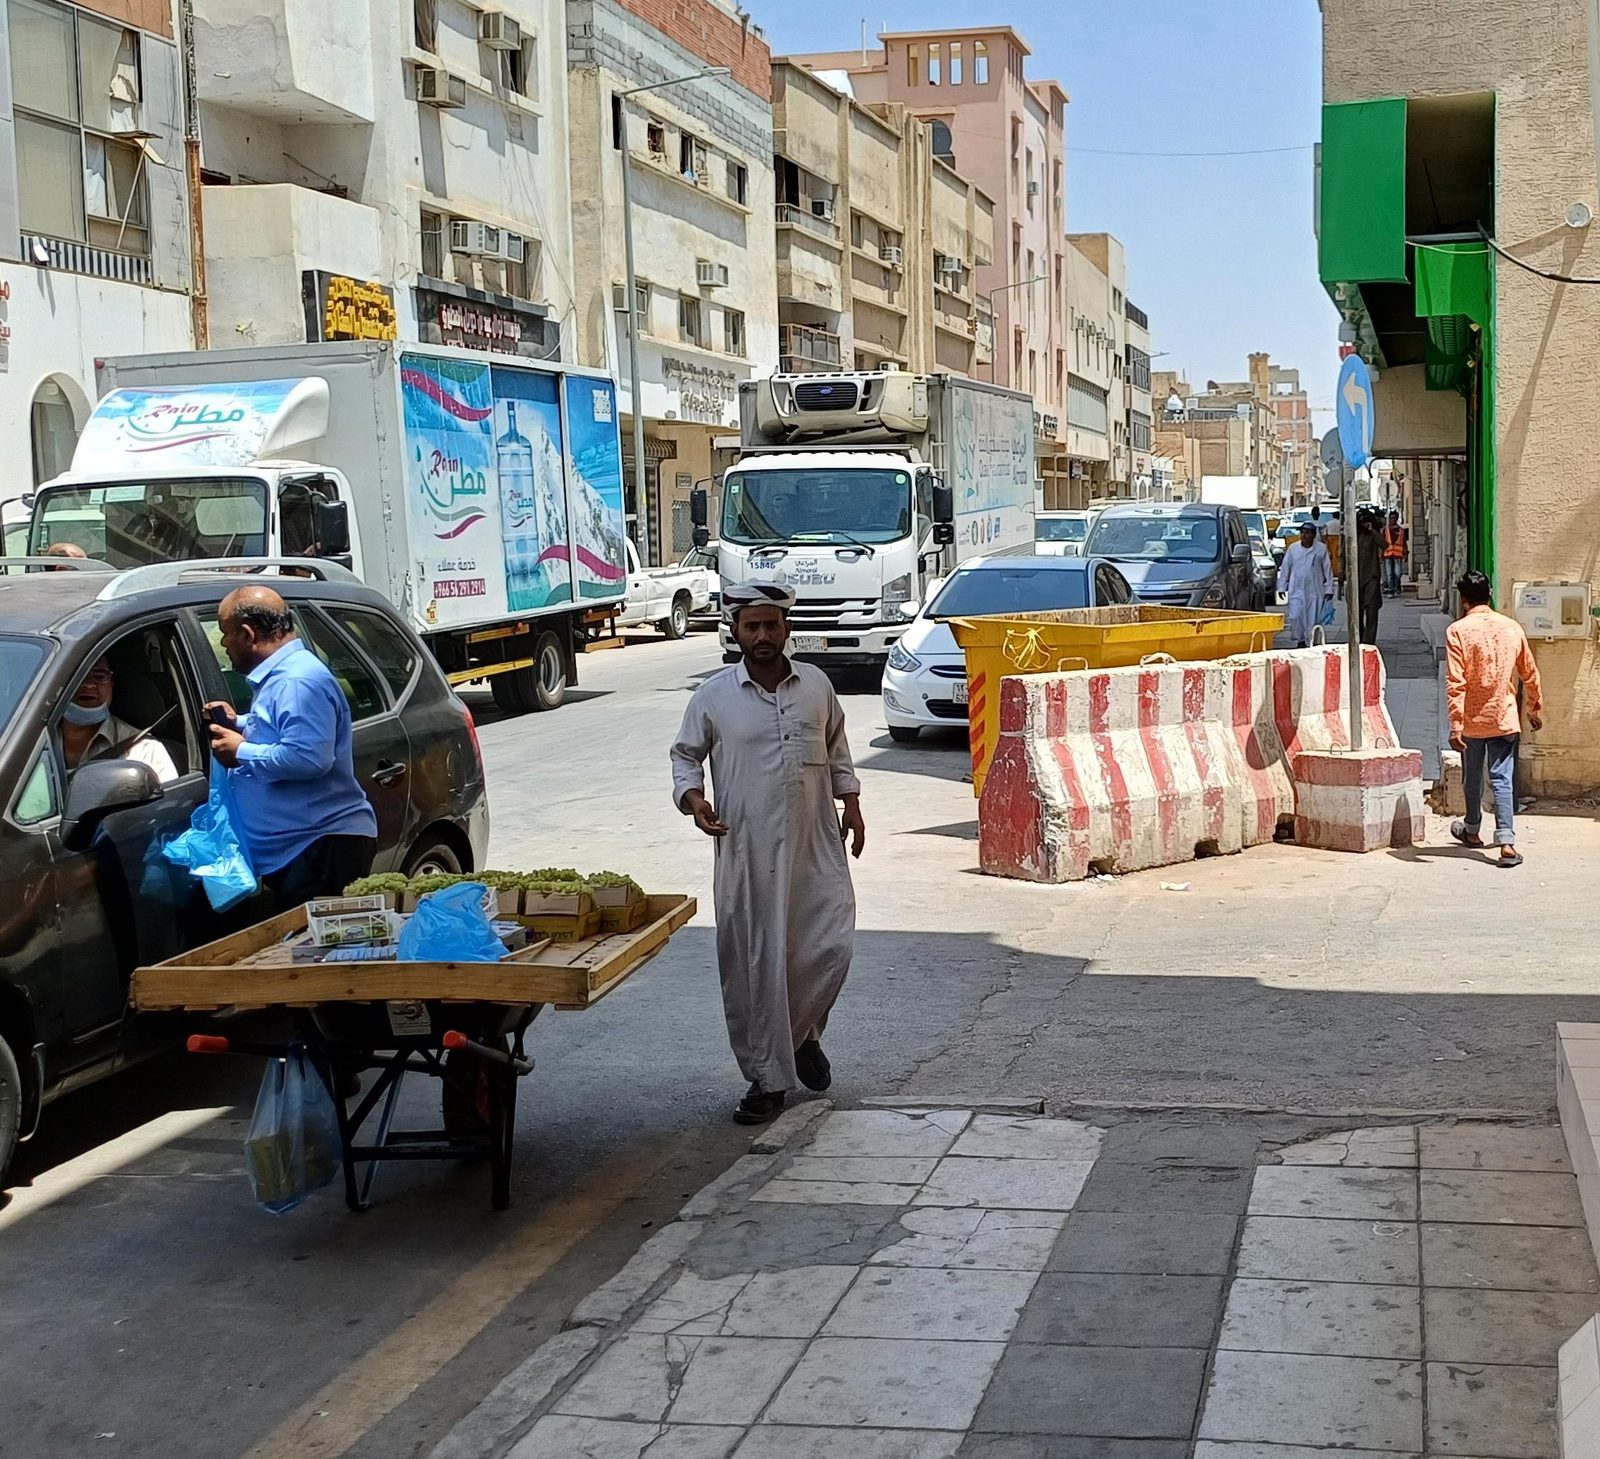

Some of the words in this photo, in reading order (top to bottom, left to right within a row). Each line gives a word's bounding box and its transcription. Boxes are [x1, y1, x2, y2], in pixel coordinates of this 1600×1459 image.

[128, 404, 245, 434] مطر
[143, 402, 200, 418] Rain
[430, 449, 459, 478] Rain
[420, 457, 487, 508] مطر
